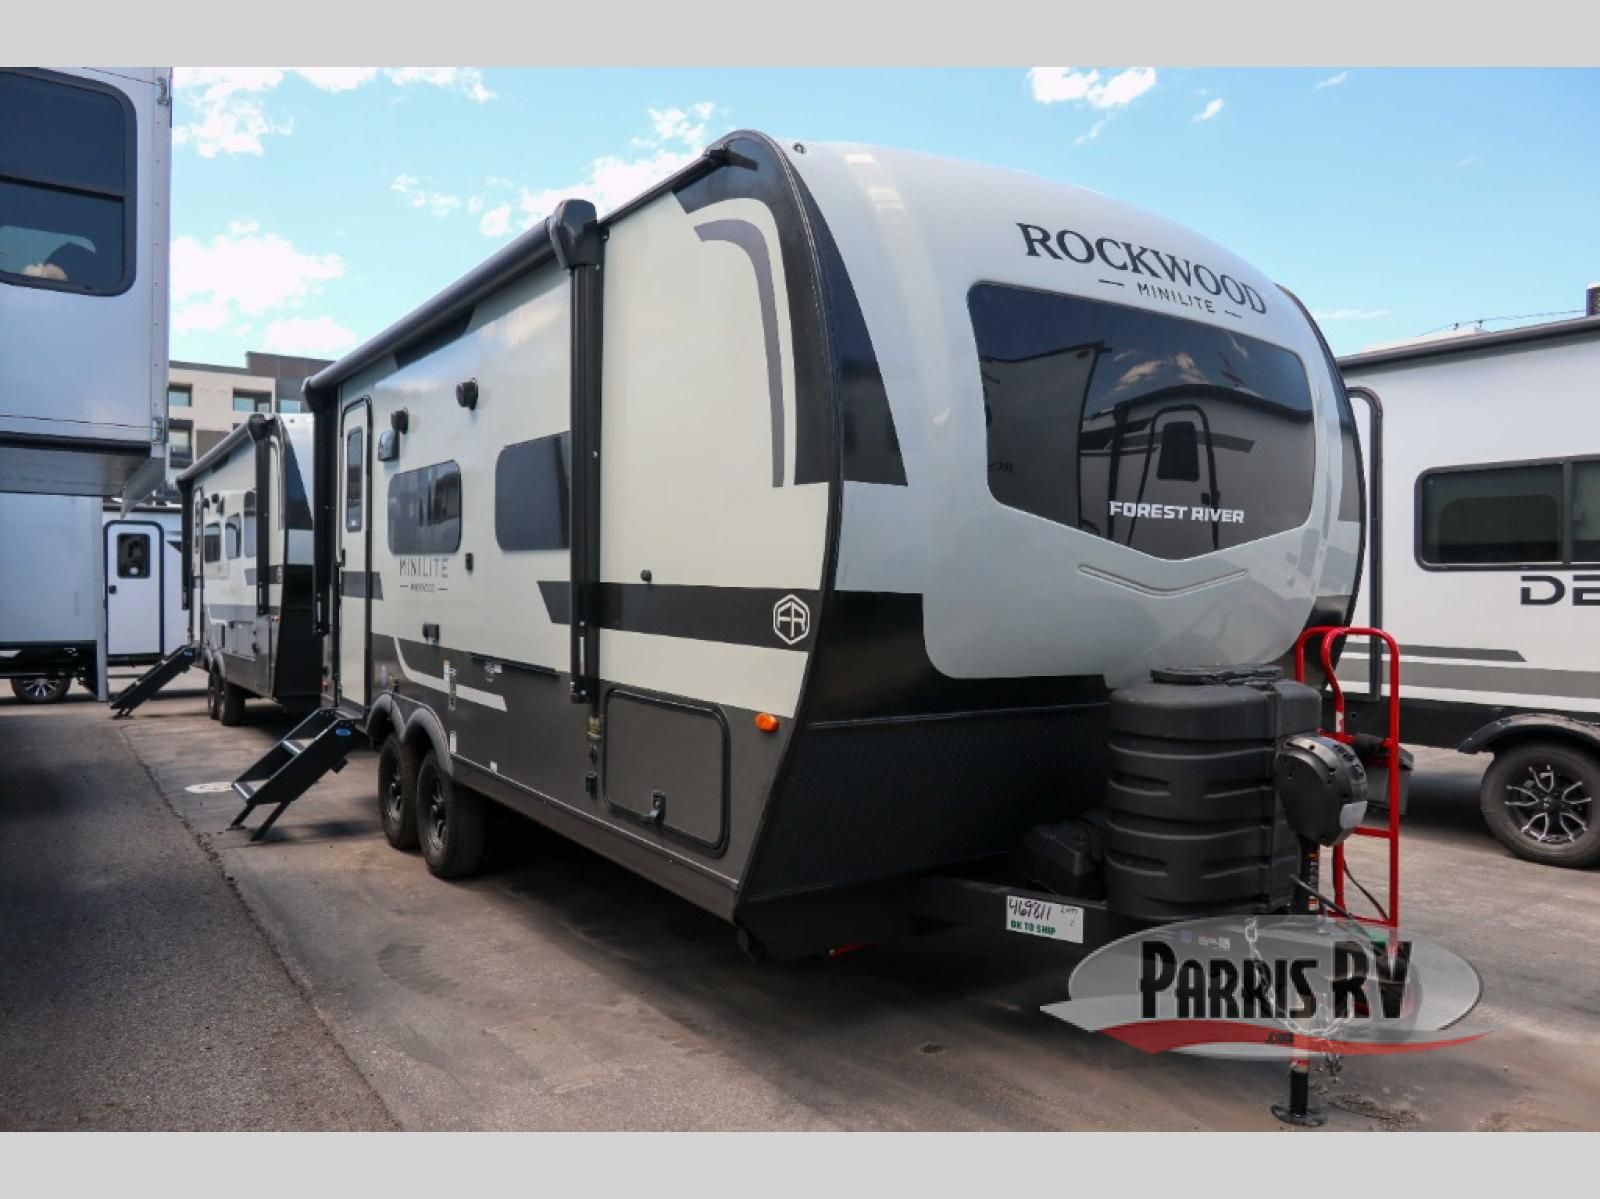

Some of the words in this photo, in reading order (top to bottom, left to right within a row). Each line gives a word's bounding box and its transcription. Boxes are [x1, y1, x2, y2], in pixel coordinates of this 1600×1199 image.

[1016, 222, 1267, 315] ROCKWOOD
[1136, 281, 1216, 314] MINILITE
[1108, 500, 1188, 520] FOREST
[1191, 506, 1245, 524] RIVER
[399, 556, 449, 578] MINILITE
[1010, 919, 1022, 930] OK
[1024, 921, 1034, 932] TO
[1036, 924, 1056, 936] SHIP
